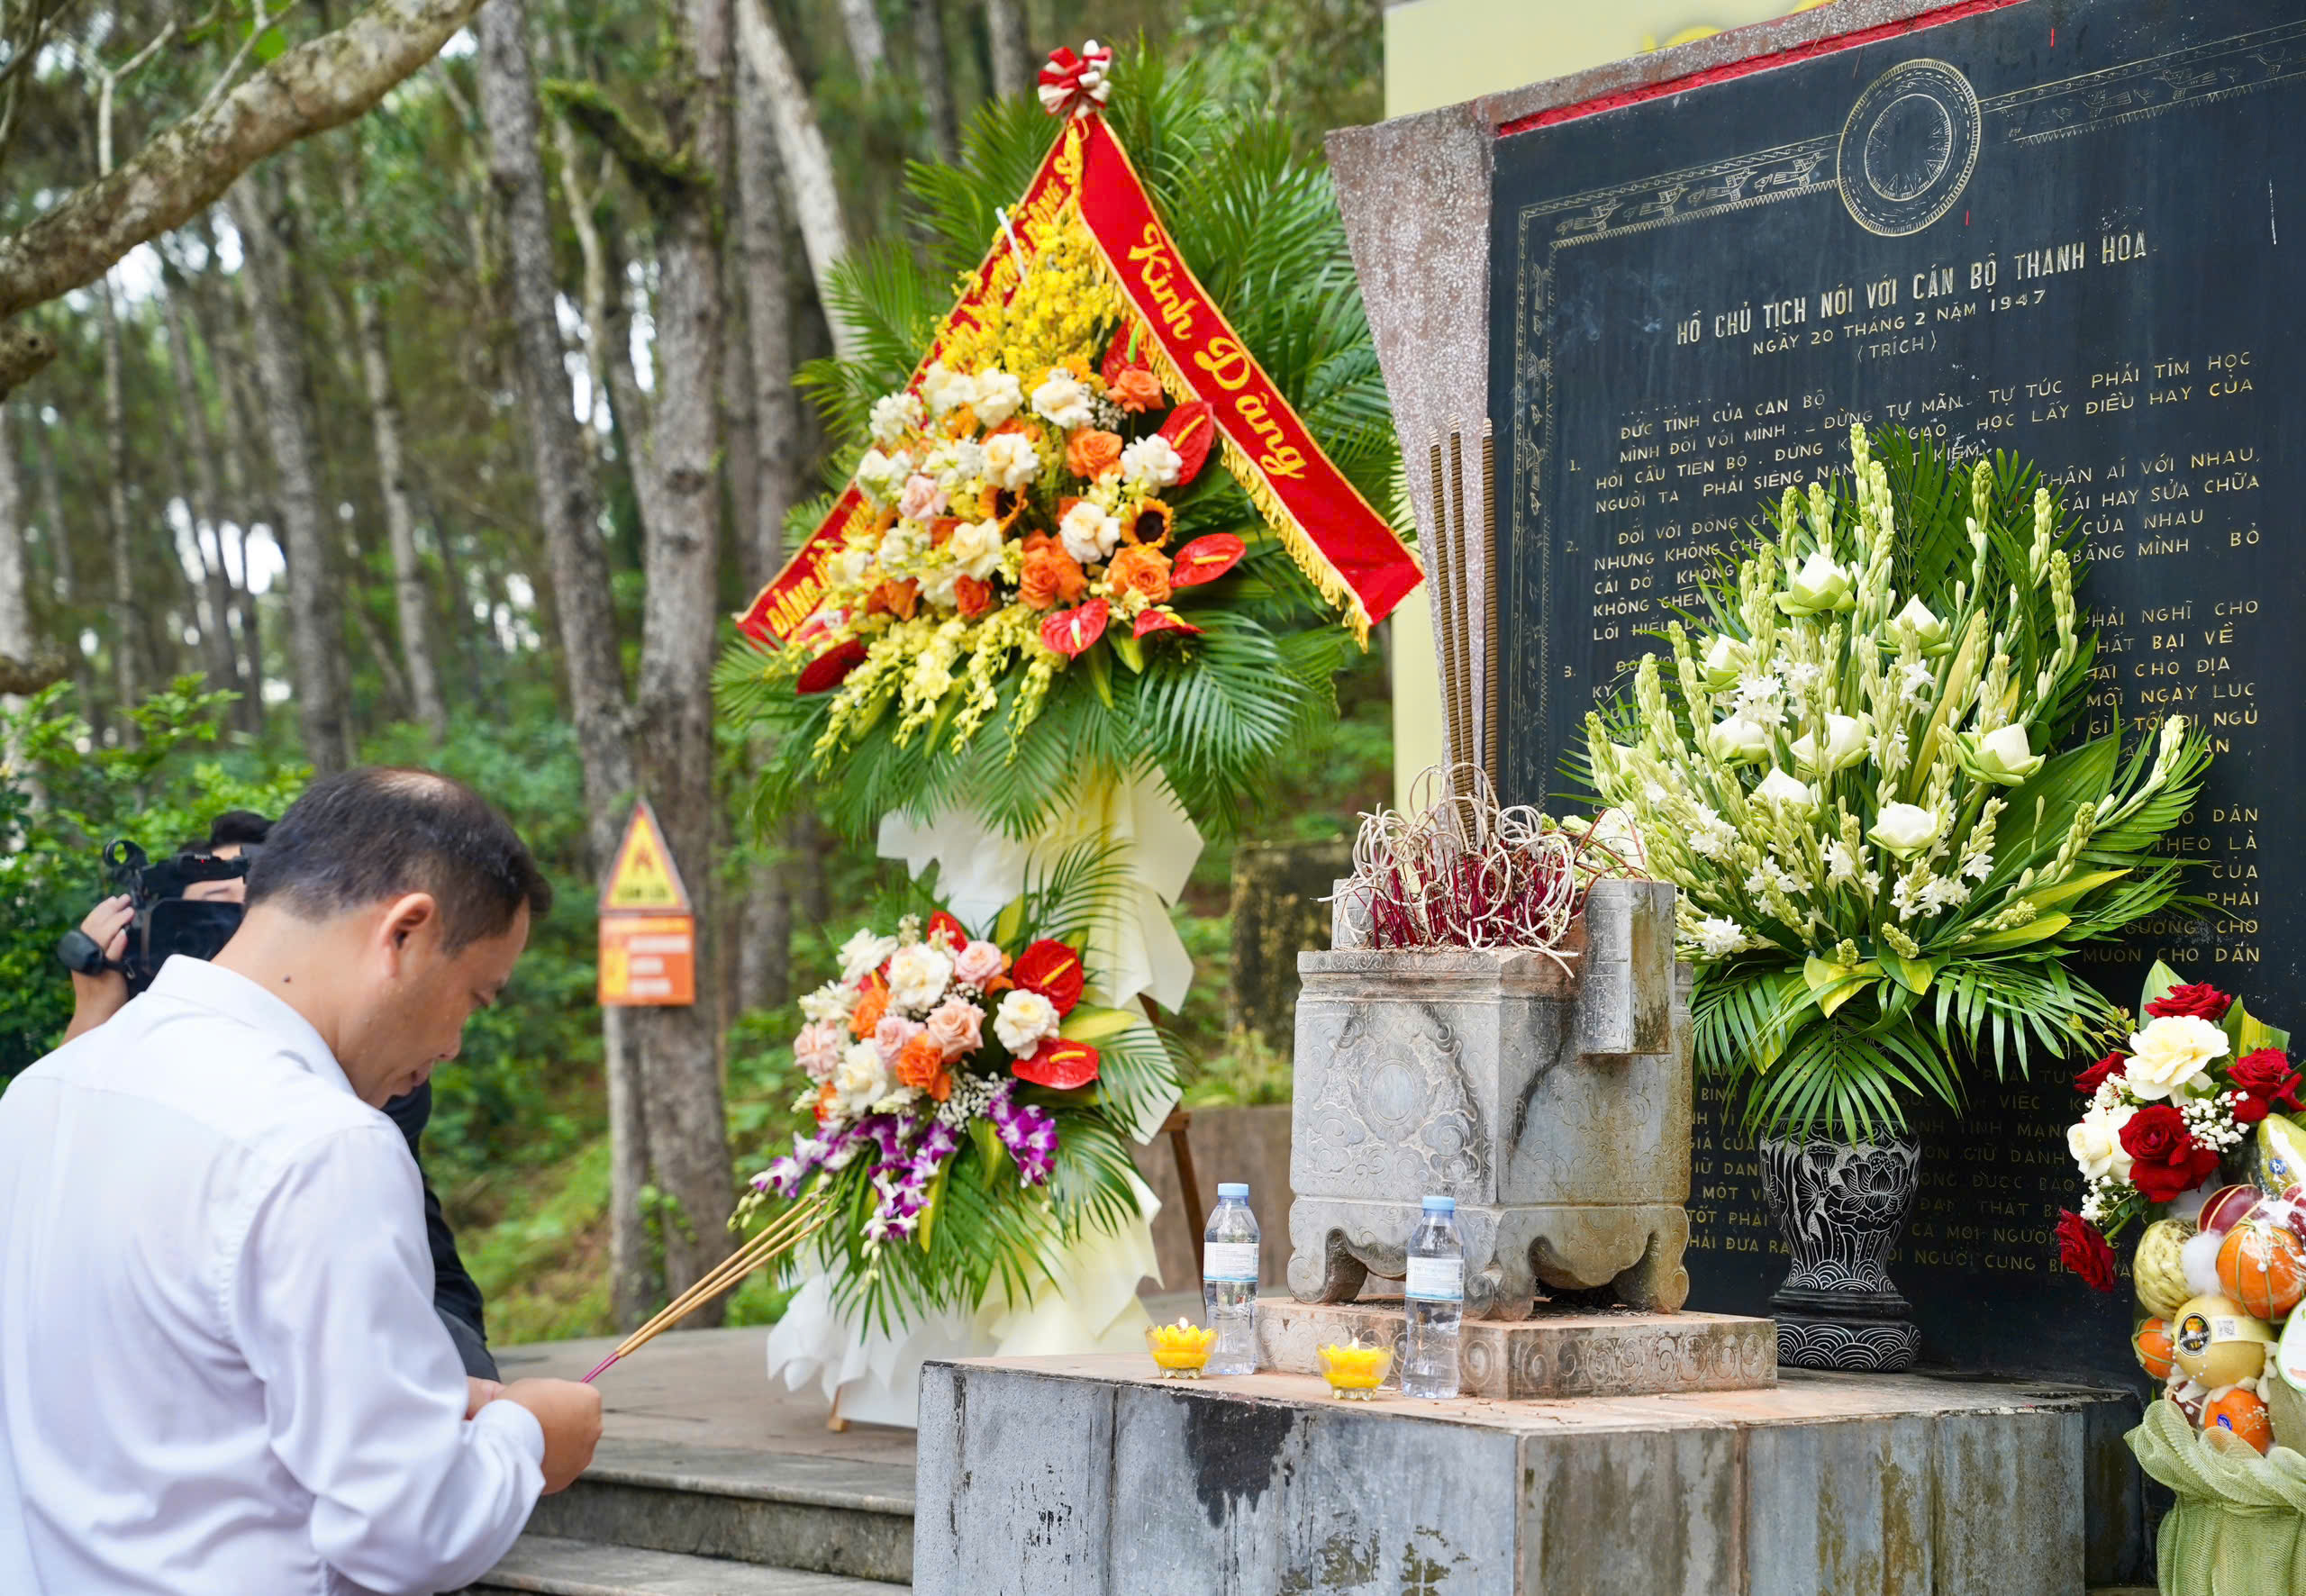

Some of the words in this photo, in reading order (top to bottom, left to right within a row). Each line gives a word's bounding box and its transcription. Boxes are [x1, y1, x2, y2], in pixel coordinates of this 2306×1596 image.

[1676, 310, 1702, 345] HỒ
[1715, 301, 1751, 338] CHỦ
[1763, 296, 1807, 331] TỊCH
[1820, 283, 1853, 318] NÓI
[1866, 274, 1897, 309] VỚI
[1912, 263, 1954, 300] CÁN
[1970, 253, 1997, 293] BỘ
[2014, 241, 2085, 281] THANH
[1753, 333, 1800, 355] NGÀY
[1811, 330, 1834, 345] 20
[1843, 311, 1906, 339] THÁNG
[1914, 312, 1926, 325] 2
[1990, 289, 2047, 312] 1947
[1127, 222, 1194, 340] Kính
[1194, 337, 1308, 479] Dâng
[1620, 444, 1660, 463] MÌNH
[1745, 422, 1785, 442] MÌNH
[1885, 400, 1911, 421] TỰ
[1988, 385, 2016, 405] TỰ
[2025, 377, 2063, 398] TÚC
[2091, 361, 2140, 389] PHẢI
[2207, 351, 2251, 374] HỌC
[1621, 418, 1653, 440] ĐỨC
[1663, 412, 1700, 432] TÍNH
[1712, 402, 1743, 422] CỦA
[1802, 389, 1825, 409] BỘ
[1596, 469, 1623, 490] HỎI
[1635, 464, 1666, 484] CẦU
[1976, 413, 2015, 432] HỌC
[2084, 390, 2135, 415] ĐIỀU
[2149, 386, 2193, 407] HAY
[2209, 374, 2254, 397] CỦA
[1658, 489, 1679, 503] TA
[1703, 475, 1743, 497] PHẢI
[1817, 459, 1856, 480] NĂN
[2040, 465, 2093, 487] THÂN
[2140, 452, 2174, 475] VỚI
[1665, 542, 1720, 562] KHÔNG
[2060, 491, 2090, 512] CÁI
[2102, 489, 2139, 507] HAY
[2150, 479, 2190, 502] SỬA
[2203, 472, 2260, 493] CHỮA
[1594, 575, 1619, 595] CÁI
[1676, 562, 1735, 585] KHÔNG
[2082, 513, 2124, 535] CỦA
[2144, 508, 2204, 530] NHAU
[1593, 596, 1650, 617] KHÔNG
[2073, 541, 2125, 564] BẰNG
[2138, 534, 2189, 556] MÌNH
[2230, 522, 2259, 547] BỎ
[2141, 600, 2193, 623] NGHĨ
[2214, 600, 2259, 616] CHO
[1593, 621, 1619, 640] LỐI
[2096, 631, 2135, 654] HẤT
[2152, 633, 2185, 653] BẠI
[2204, 621, 2234, 646] VỀ
[2134, 661, 2180, 677] CHO
[2197, 656, 2230, 676] ĐỊA
[2140, 681, 2199, 703] NGÀY
[2090, 714, 2109, 734] GÌ
[2213, 703, 2258, 727] NGỦ
[2212, 803, 2258, 822] DÂN
[2156, 837, 2211, 852] THEO
[2229, 829, 2257, 850] LÀ
[2212, 856, 2258, 879] CỦA
[2216, 919, 2258, 934] CHO
[2156, 947, 2200, 962] CHO
[2010, 1148, 2065, 1165] DANH
[1686, 1204, 1718, 1224] TỐT
[1689, 1229, 1716, 1249] HẢI
[1725, 1237, 1759, 1253] ĐƯA
[1768, 1239, 1791, 1254] RA
